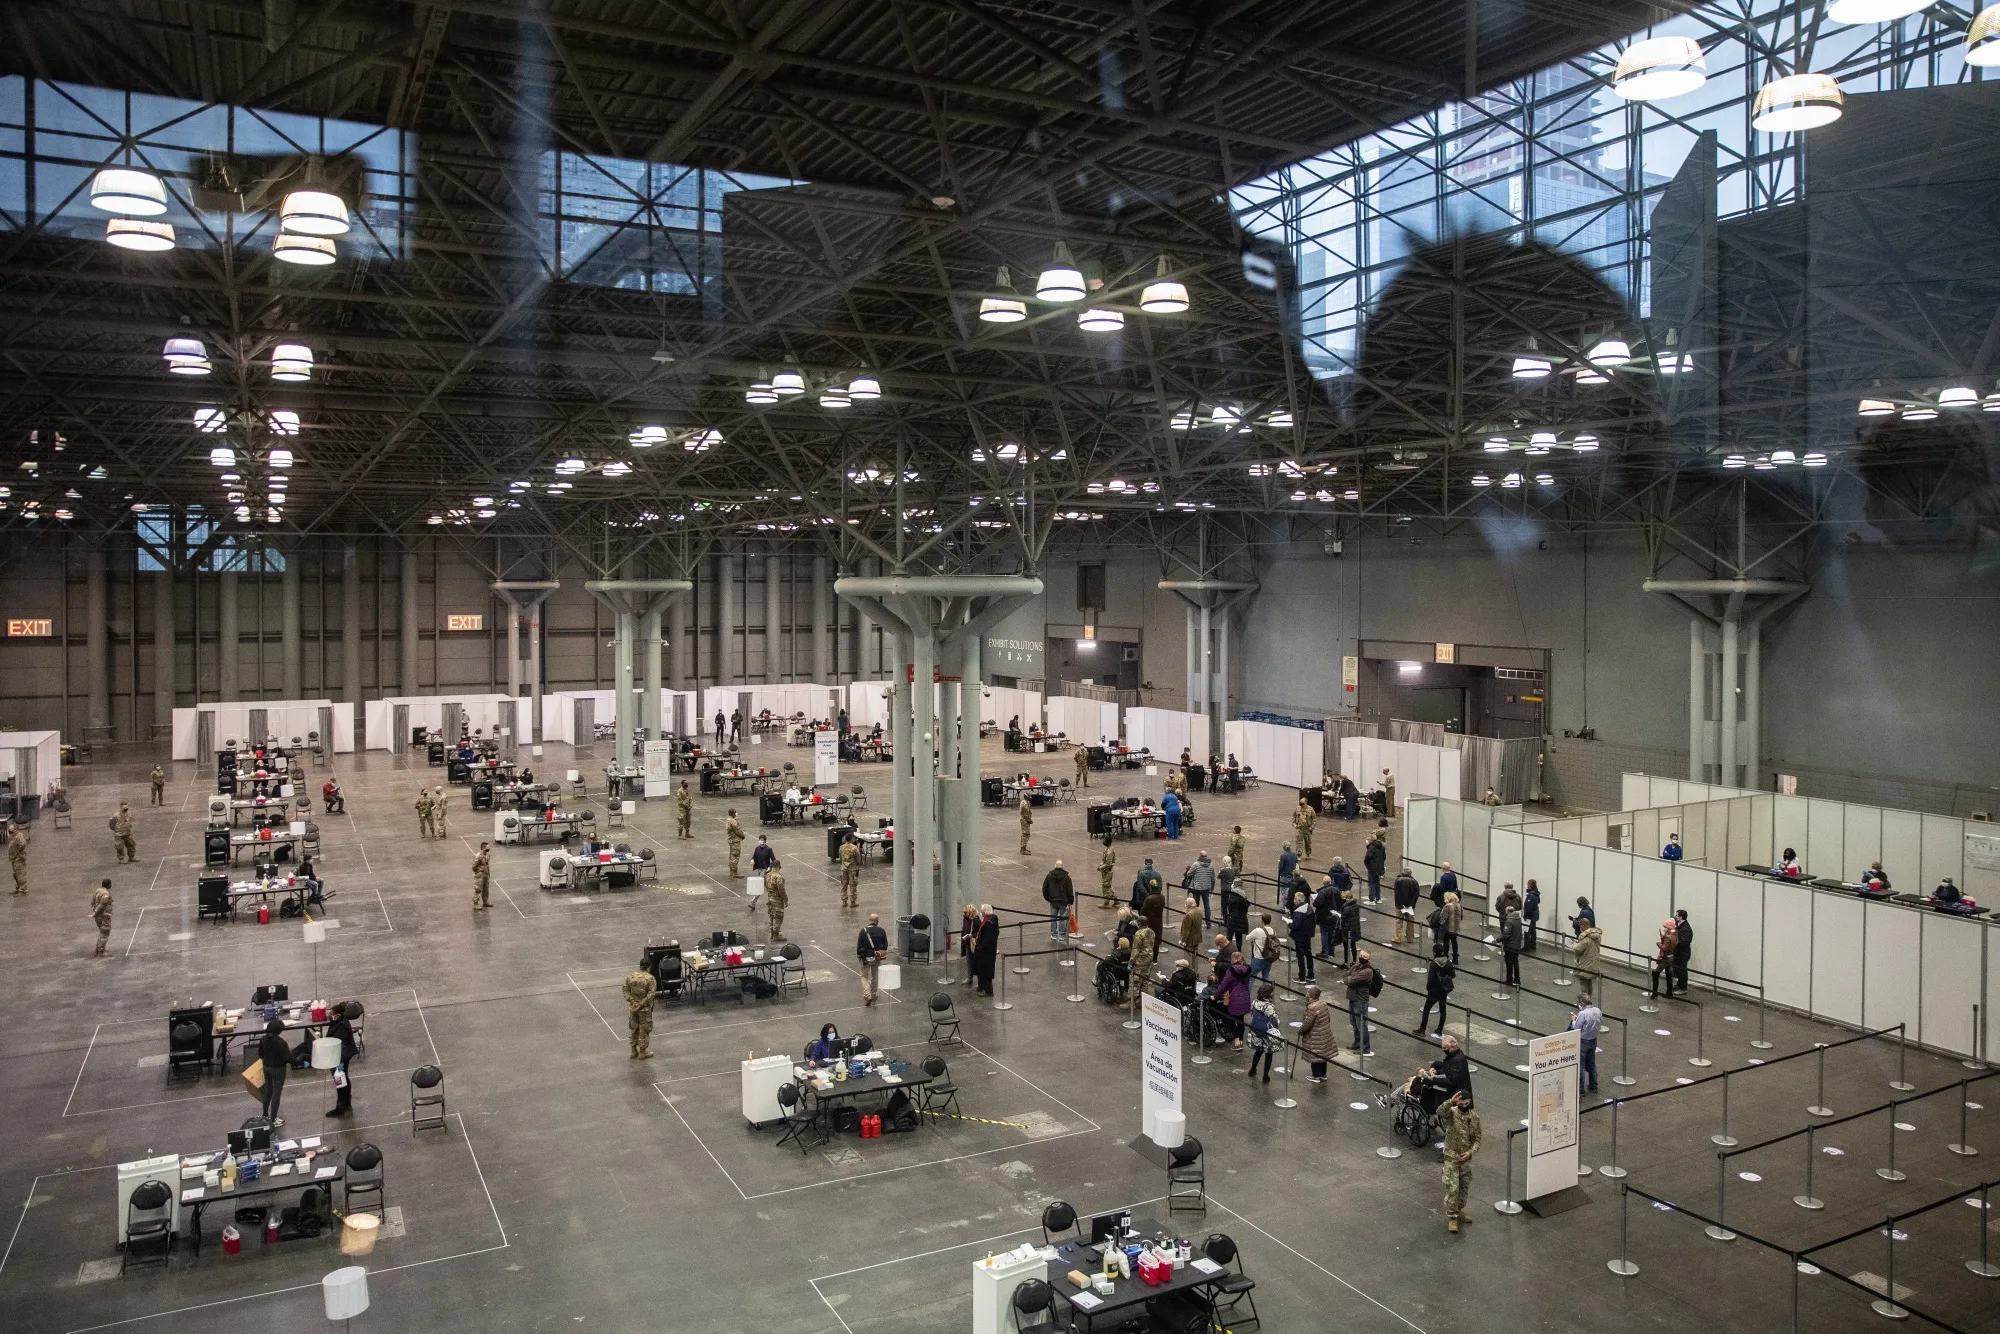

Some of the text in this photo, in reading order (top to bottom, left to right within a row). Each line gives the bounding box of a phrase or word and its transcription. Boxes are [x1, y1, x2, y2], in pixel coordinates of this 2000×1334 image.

[10, 620, 50, 635] EXIT
[450, 616, 481, 629] EXIT
[989, 638, 1043, 651] EXHIBIT SOLUTIONS
[1437, 646, 1453, 660] EXIT
[1145, 1017, 1178, 1041] Vaccination
[1154, 1033, 1169, 1047] Area
[1535, 1043, 1577, 1057] Vaccination Center
[1150, 1051, 1173, 1071] Área de
[1535, 1054, 1577, 1070] You Are Here:
[1145, 1059, 1178, 1084] Vacunación
